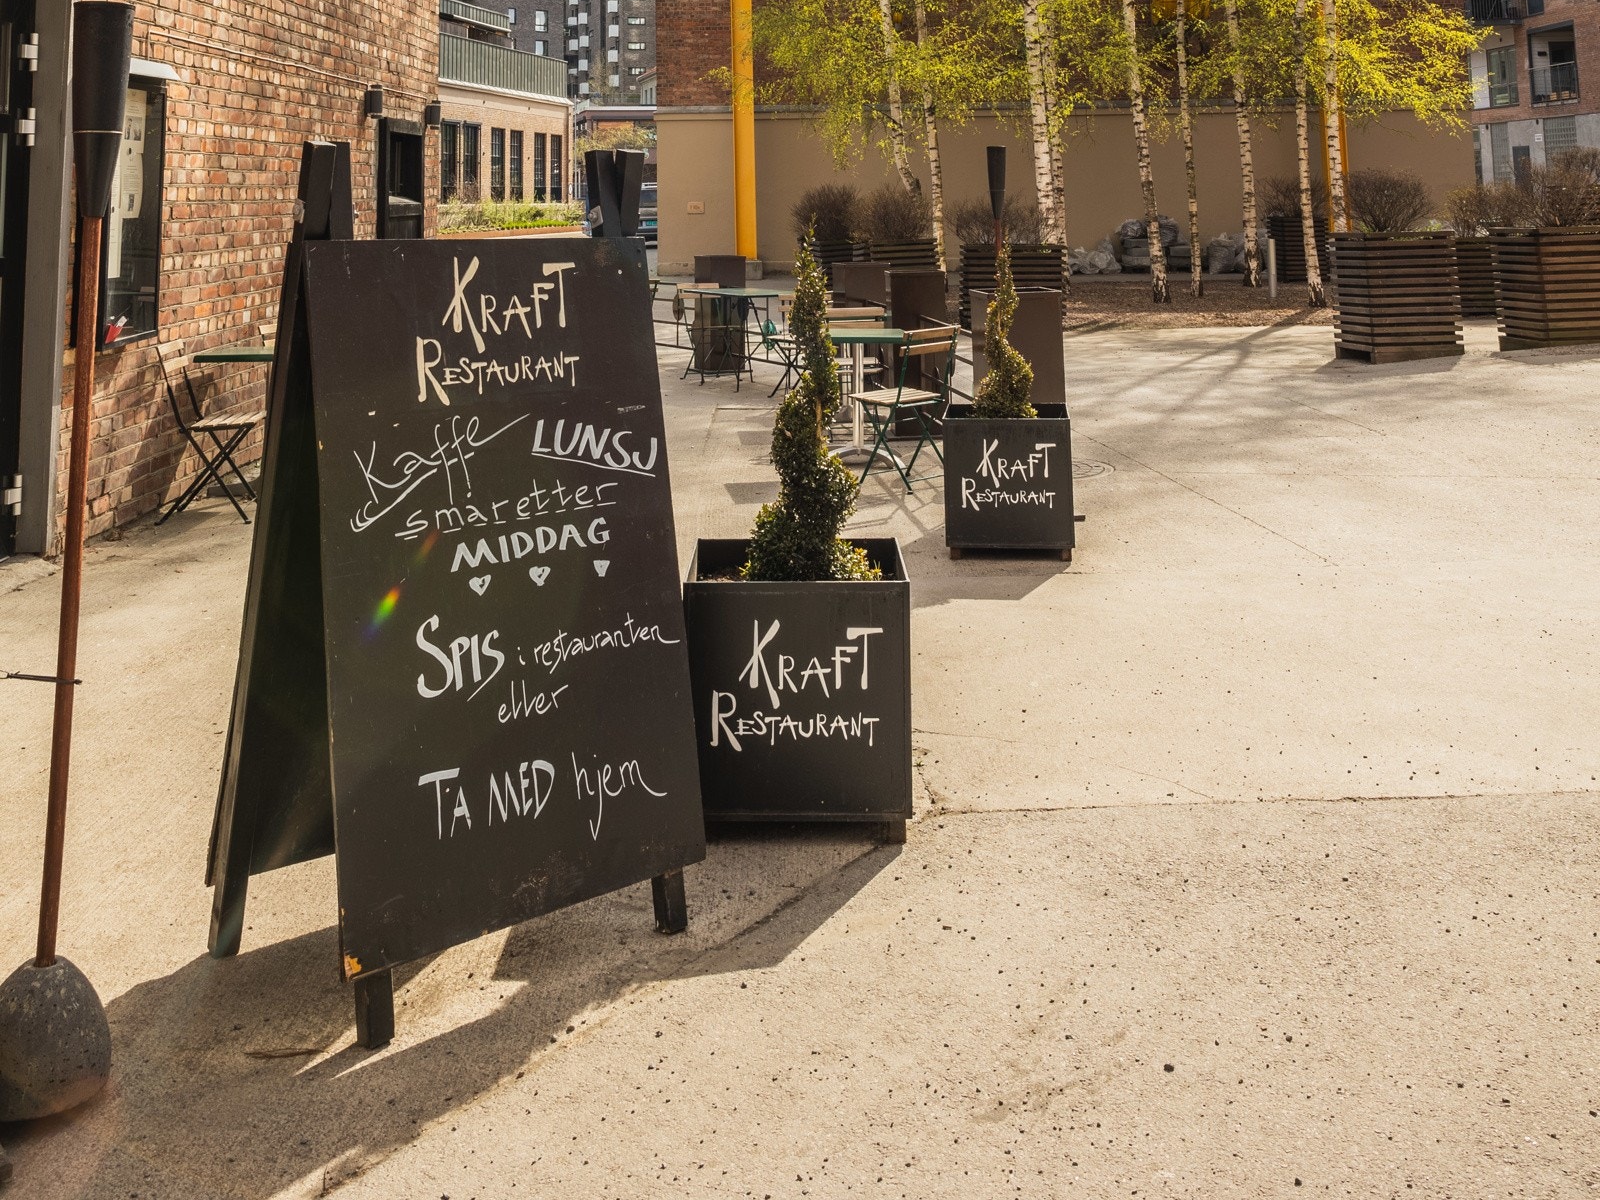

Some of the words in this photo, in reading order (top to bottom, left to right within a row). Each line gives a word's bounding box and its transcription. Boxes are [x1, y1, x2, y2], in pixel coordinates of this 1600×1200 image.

[442, 256, 576, 354] KRAFT
[417, 336, 580, 406] RESTAURANT
[353, 415, 531, 505] Kaffe
[532, 419, 658, 471] LUNSJ
[961, 477, 1056, 512] RESTAURANT
[976, 438, 1057, 488] KRAFT
[450, 517, 611, 573] MIDDAG
[416, 615, 505, 702] SPIS
[533, 612, 681, 674] restauranten
[738, 619, 884, 709] KRAFT
[498, 680, 569, 724] eller
[710, 690, 880, 753] RESTAURANT
[489, 759, 556, 827] MED
[571, 751, 668, 842] hjem
